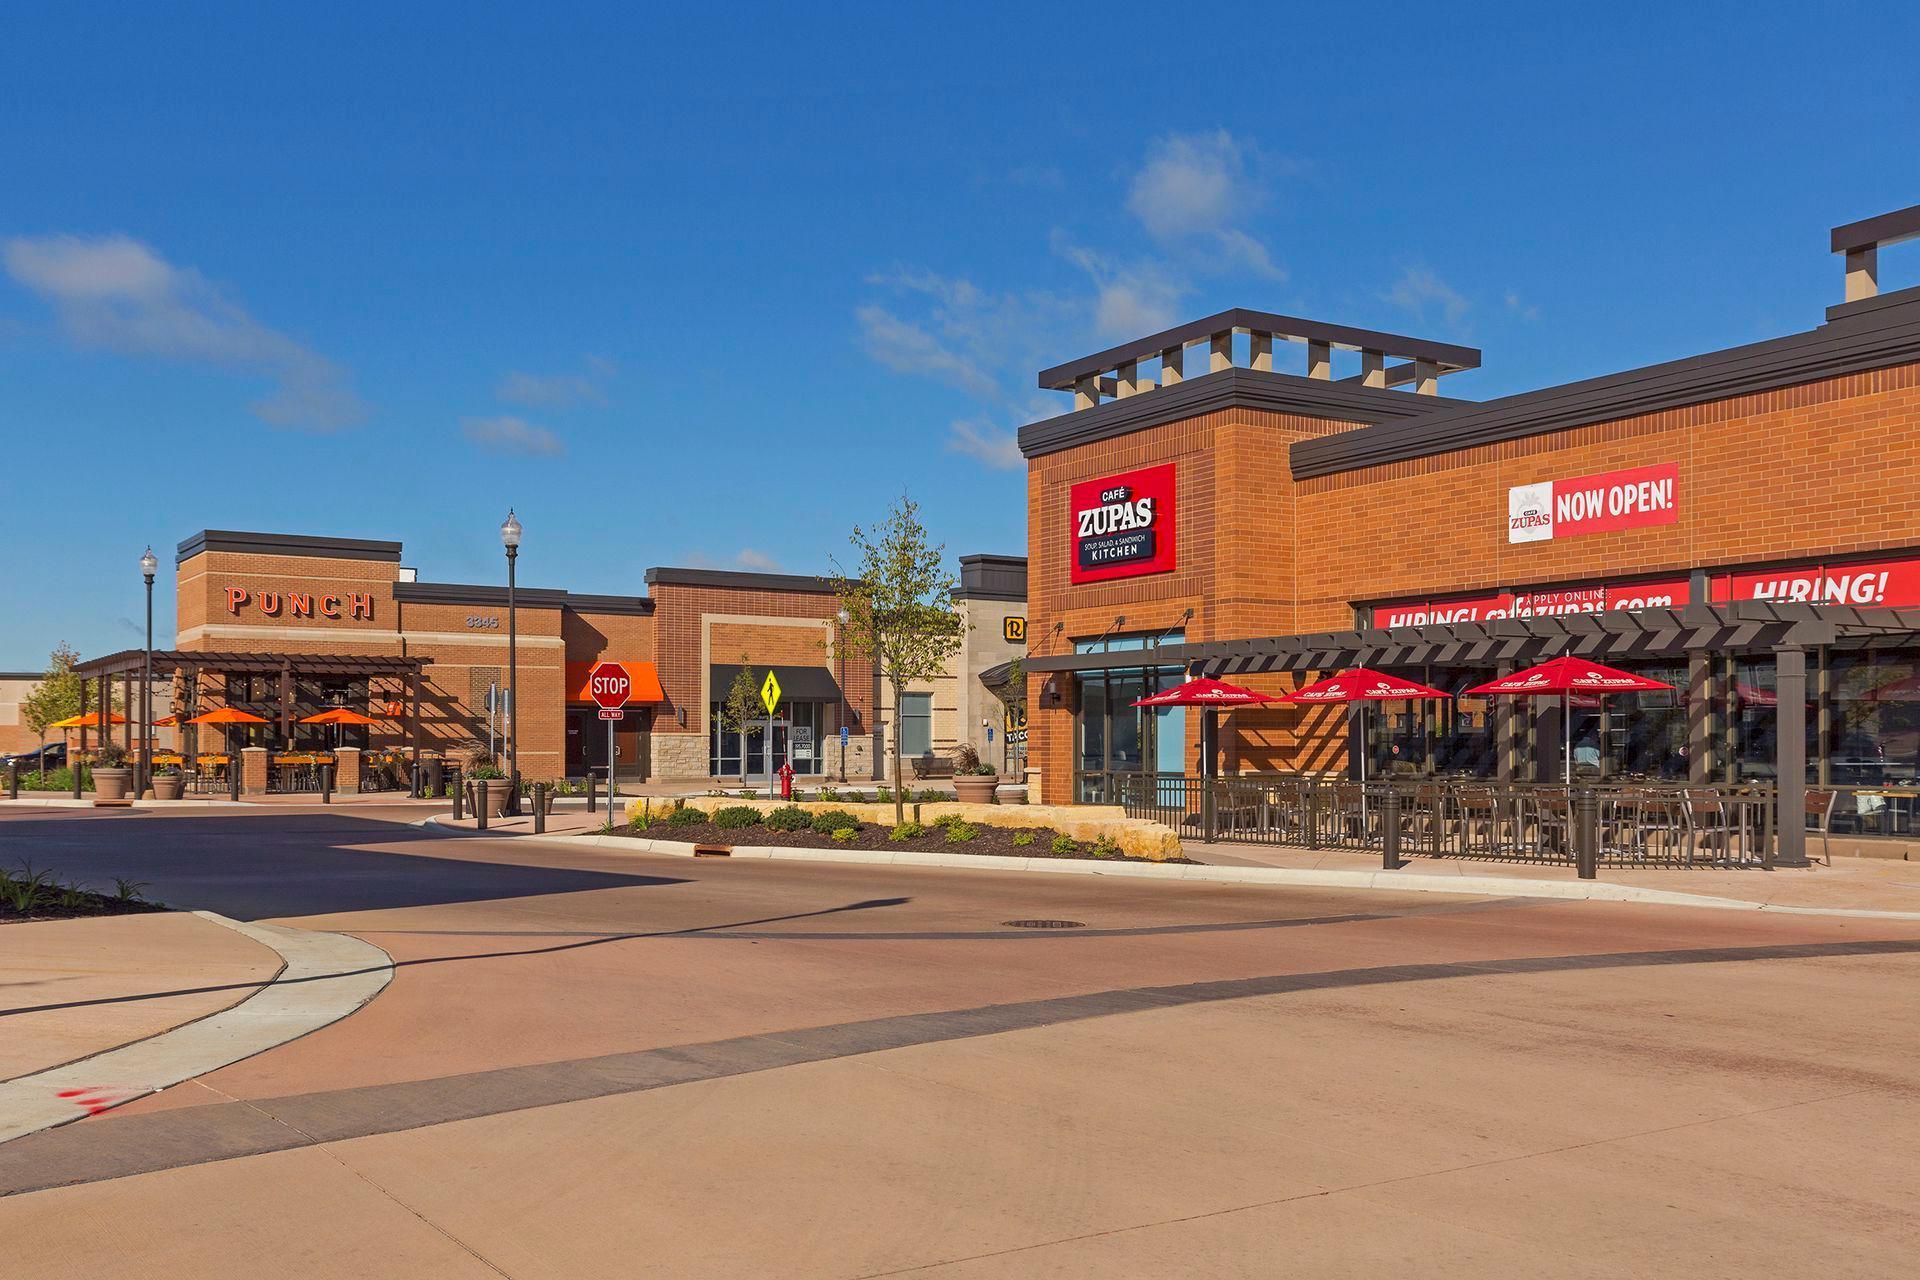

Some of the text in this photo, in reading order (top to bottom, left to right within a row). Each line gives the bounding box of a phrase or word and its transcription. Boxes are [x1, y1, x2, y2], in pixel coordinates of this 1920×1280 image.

[1102, 486, 1125, 502] CAFÉ
[1557, 477, 1673, 524] NOW OPEN!
[1077, 497, 1152, 538] ZUPAS
[1511, 513, 1550, 530] ZUPAS
[1119, 534, 1146, 546] SANDWICH
[1091, 544, 1138, 561] KITCHEN
[1753, 571, 1890, 606] HIRING!
[224, 586, 372, 619] PUNCH
[1485, 594, 1672, 622] cafezupascom
[1526, 594, 1560, 606] APPLY
[466, 615, 499, 628] 3345
[1007, 620, 1023, 637] R
[593, 677, 629, 694] STOP
